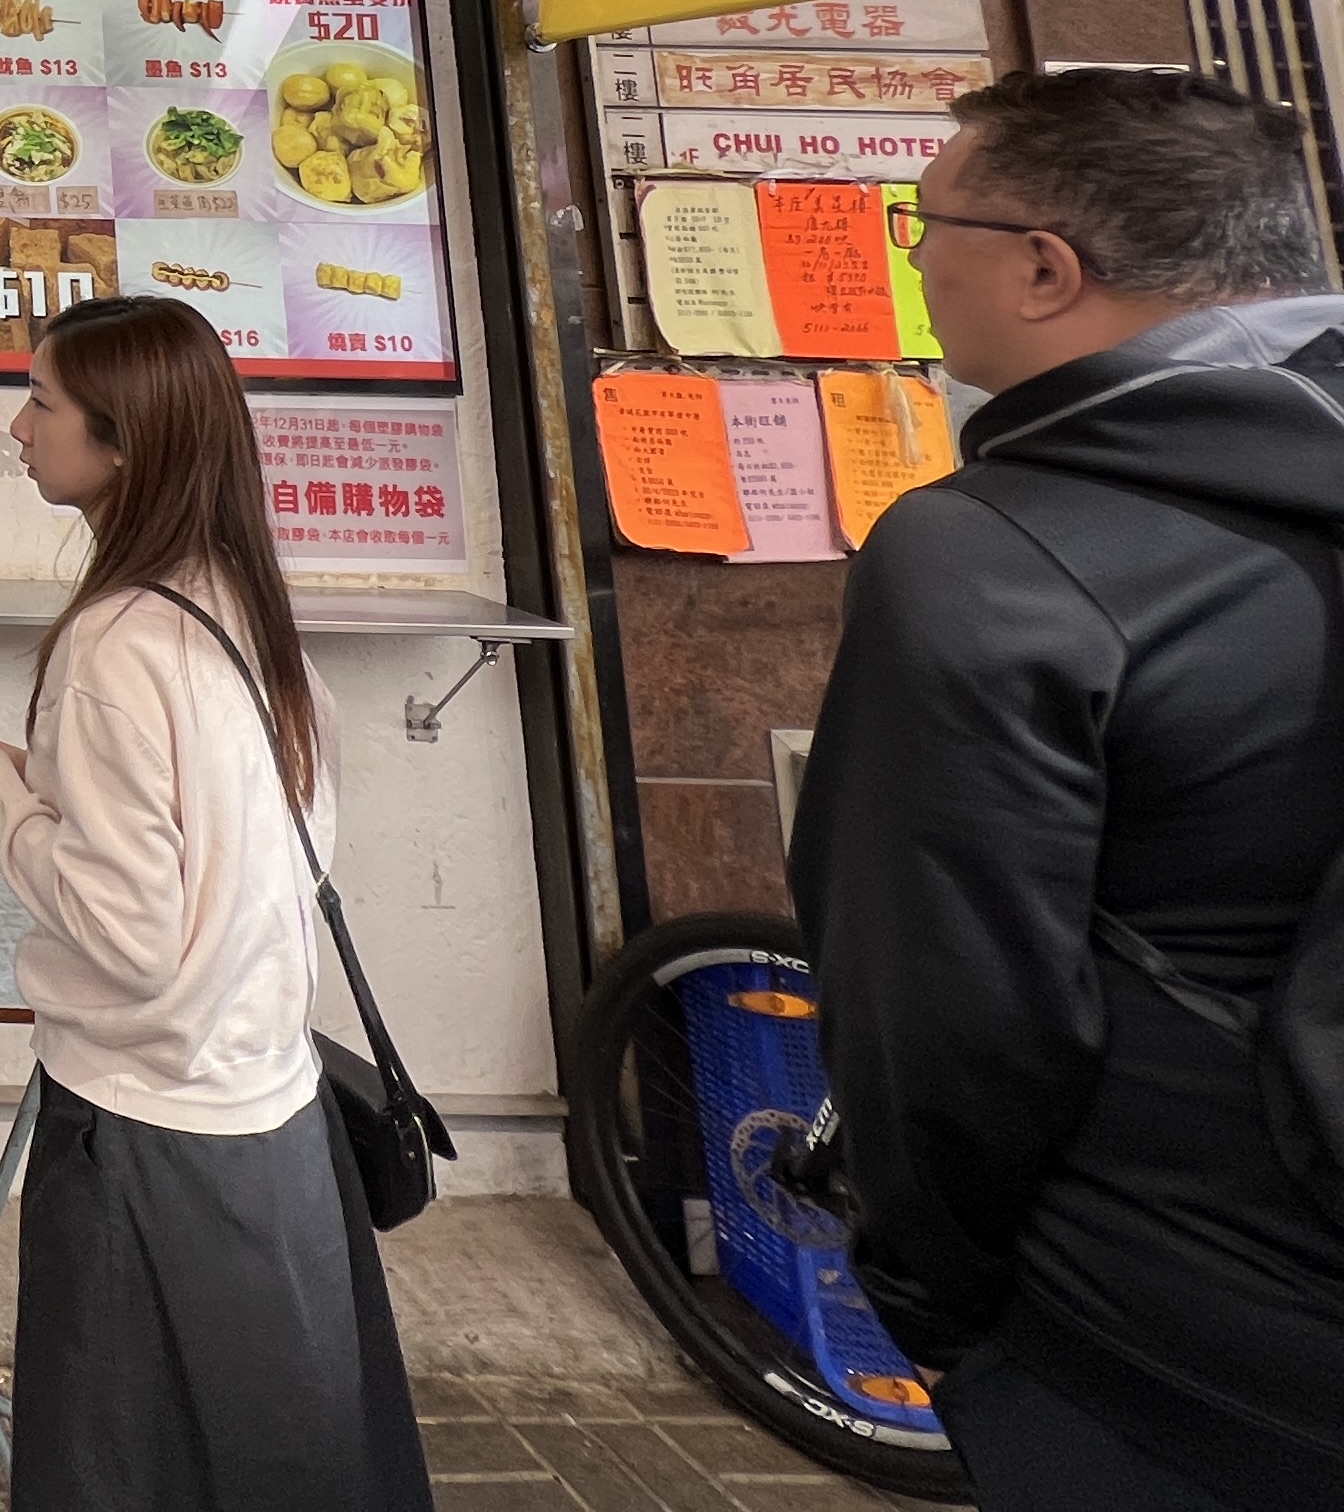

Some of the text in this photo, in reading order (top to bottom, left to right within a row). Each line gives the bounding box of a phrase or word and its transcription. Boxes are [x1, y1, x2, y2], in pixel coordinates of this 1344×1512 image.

[308, 11, 379, 42] $20
[40, 59, 78, 76] $13
[190, 61, 228, 79] $13
[675, 63, 967, 102] 旺角居民協會
[713, 133, 783, 155] CHUI
[800, 135, 840, 156] HO
[59, 192, 93, 210] $25
[220, 329, 260, 347] $16
[328, 333, 413, 352] 燒賣 $10
[272, 480, 446, 518] 自備購物袋
